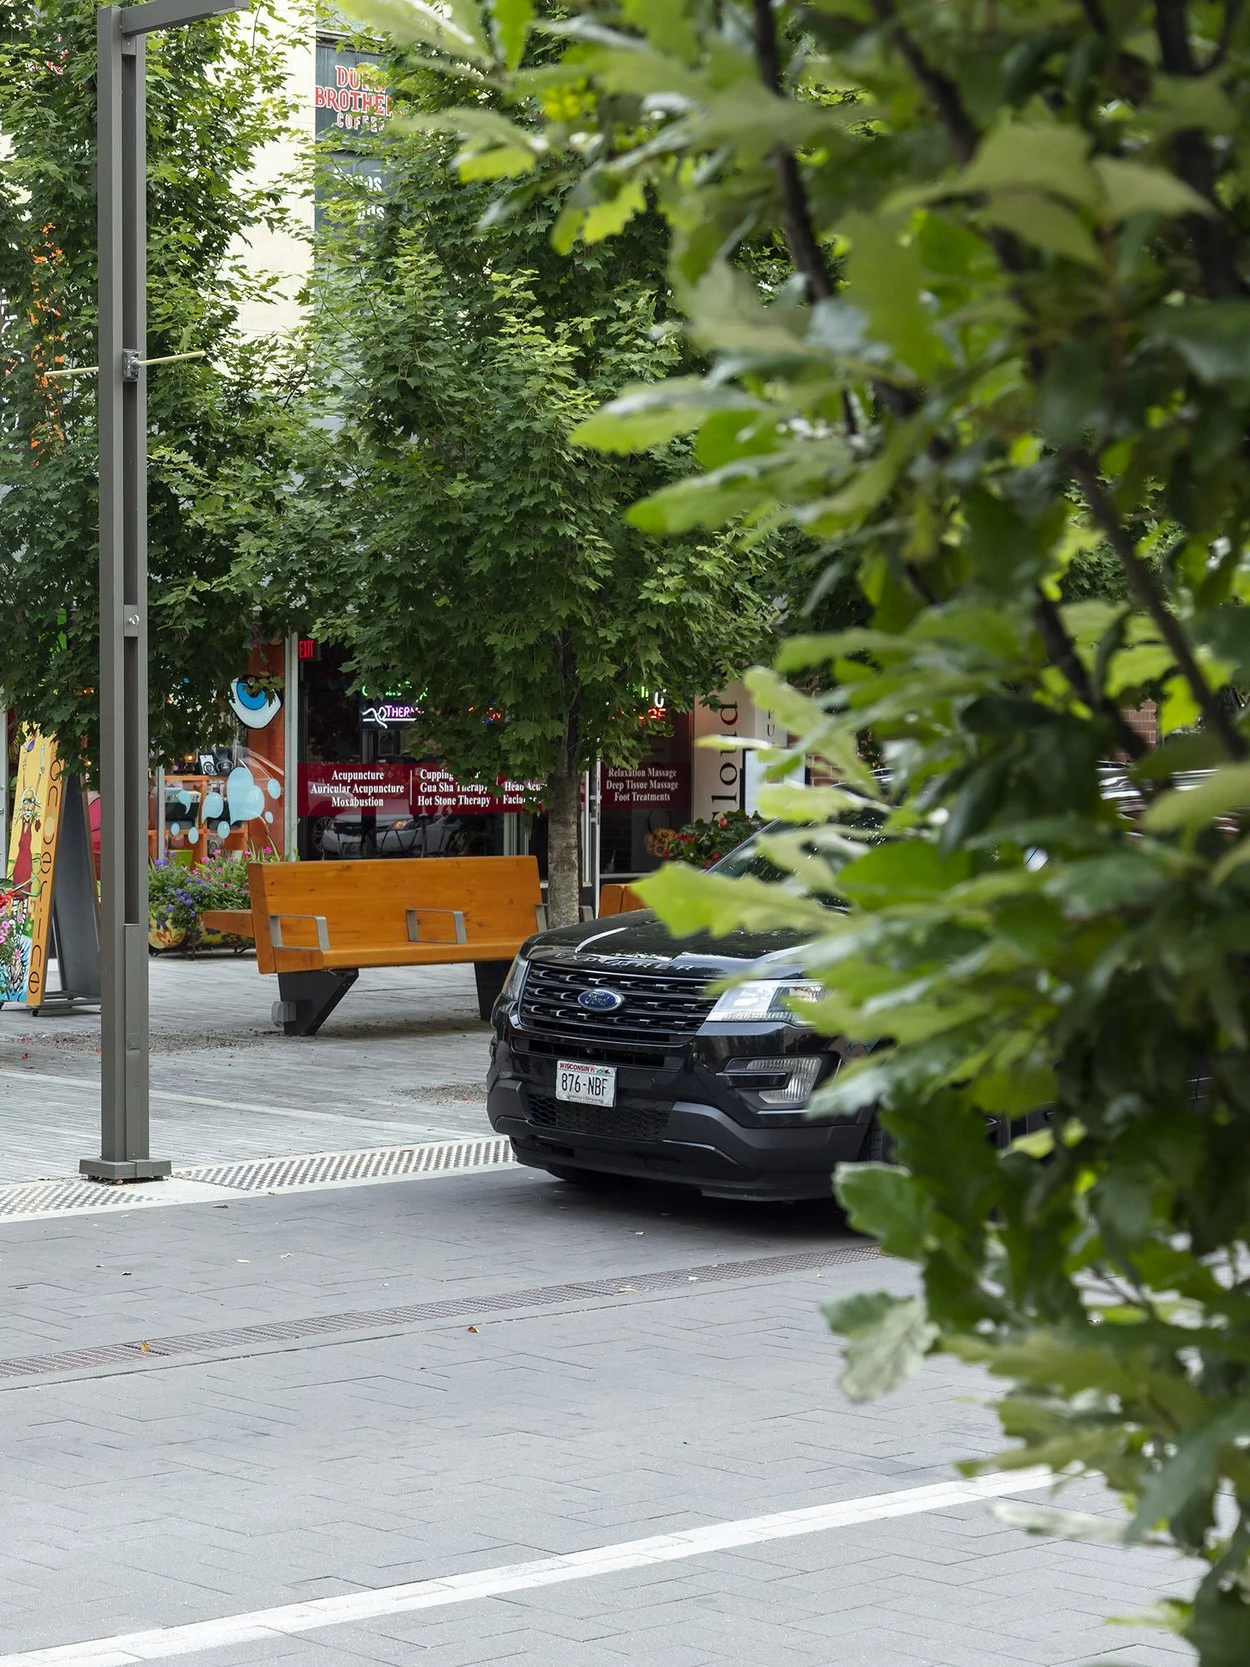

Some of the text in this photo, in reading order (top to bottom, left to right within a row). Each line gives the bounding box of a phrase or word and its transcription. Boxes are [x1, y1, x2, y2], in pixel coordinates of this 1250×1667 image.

[335, 64, 387, 93] DU
[315, 85, 403, 117] BROTHE
[298, 640, 315, 658] EXIT
[710, 702, 739, 820] loud
[331, 770, 385, 783] Acupuncture
[420, 769, 454, 782] Cupping
[608, 768, 677, 778] Relaxation Massage
[311, 783, 405, 796] Auricular Acupuncture
[420, 782, 437, 793] Gua
[439, 782, 454, 793] Sha
[606, 780, 679, 791] Deep Tissue Massage
[331, 796, 384, 808] Moxabustion
[417, 795, 491, 808] Hot Stone Therapy
[614, 791, 671, 802] Foot Treatments
[559, 1062, 590, 1073] WISCONSIN
[561, 1072, 608, 1097] 876-NBF
